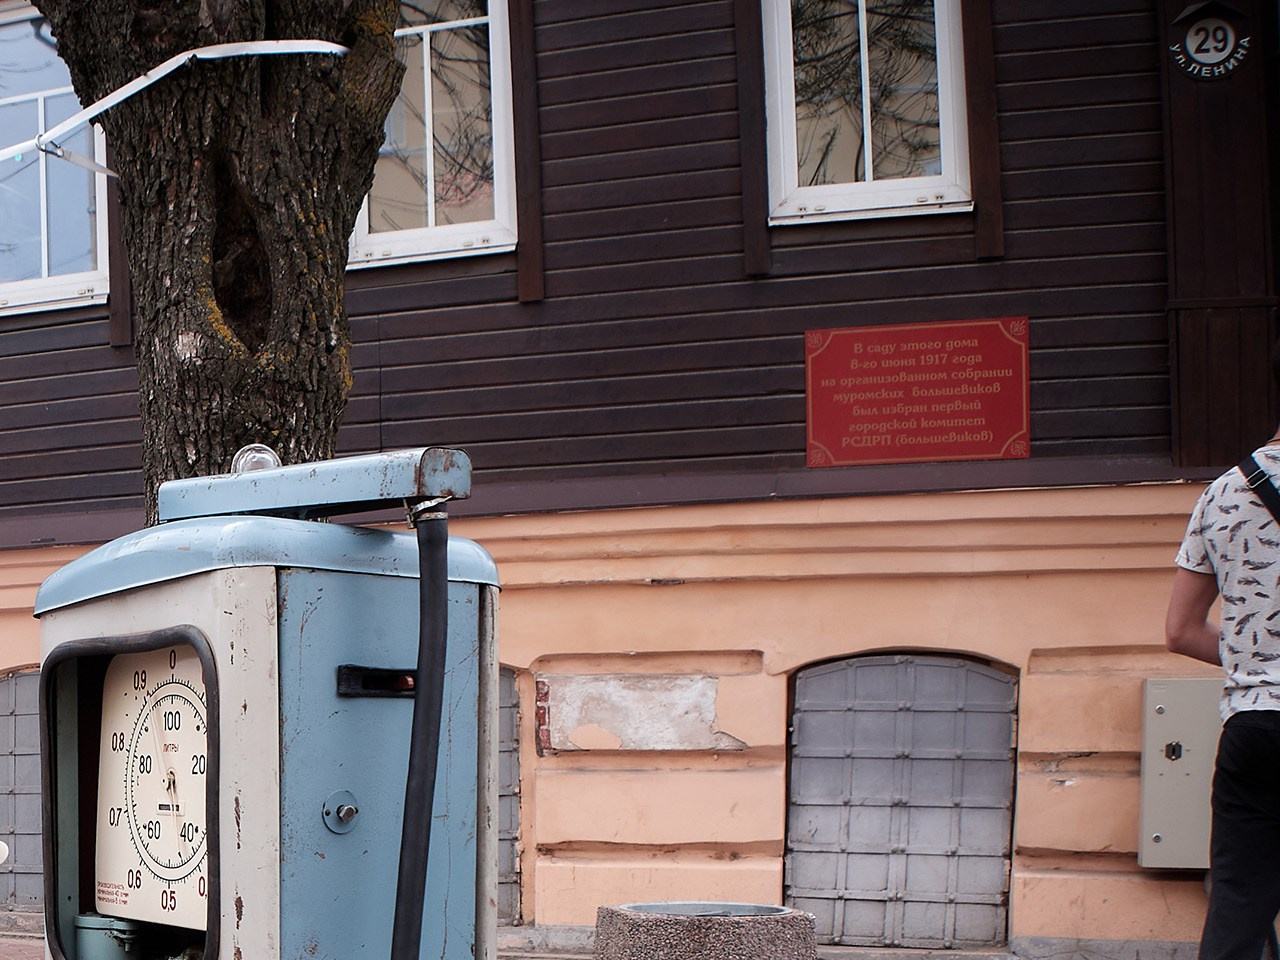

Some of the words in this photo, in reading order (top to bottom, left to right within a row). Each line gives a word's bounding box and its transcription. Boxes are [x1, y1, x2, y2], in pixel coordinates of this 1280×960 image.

[1194, 26, 1228, 54] 29
[1187, 36, 1251, 77] ЛЕНИНА
[854, 343, 863, 354] В
[867, 343, 896, 355] саду
[900, 341, 941, 352] этого
[946, 338, 978, 350] дома
[881, 358, 916, 367] июня
[920, 353, 948, 365] 1917
[952, 354, 982, 365] года
[821, 378, 836, 387] на
[840, 371, 947, 387] организованном
[951, 368, 1013, 380] собрании
[833, 389, 904, 404] муромских
[912, 382, 1001, 397] большевиков
[853, 405, 878, 416] был
[882, 403, 927, 416] избран
[932, 399, 981, 414] первый
[849, 419, 916, 433] городской
[921, 416, 985, 428] комитет
[842, 435, 891, 447] РСДРП
[896, 431, 993, 446] (большевиков)
[169, 650, 176, 669] 0
[163, 711, 181, 731] 100
[139, 755, 152, 774] 80
[192, 754, 206, 775] 20
[147, 820, 161, 840] 60
[180, 822, 194, 842] 40
